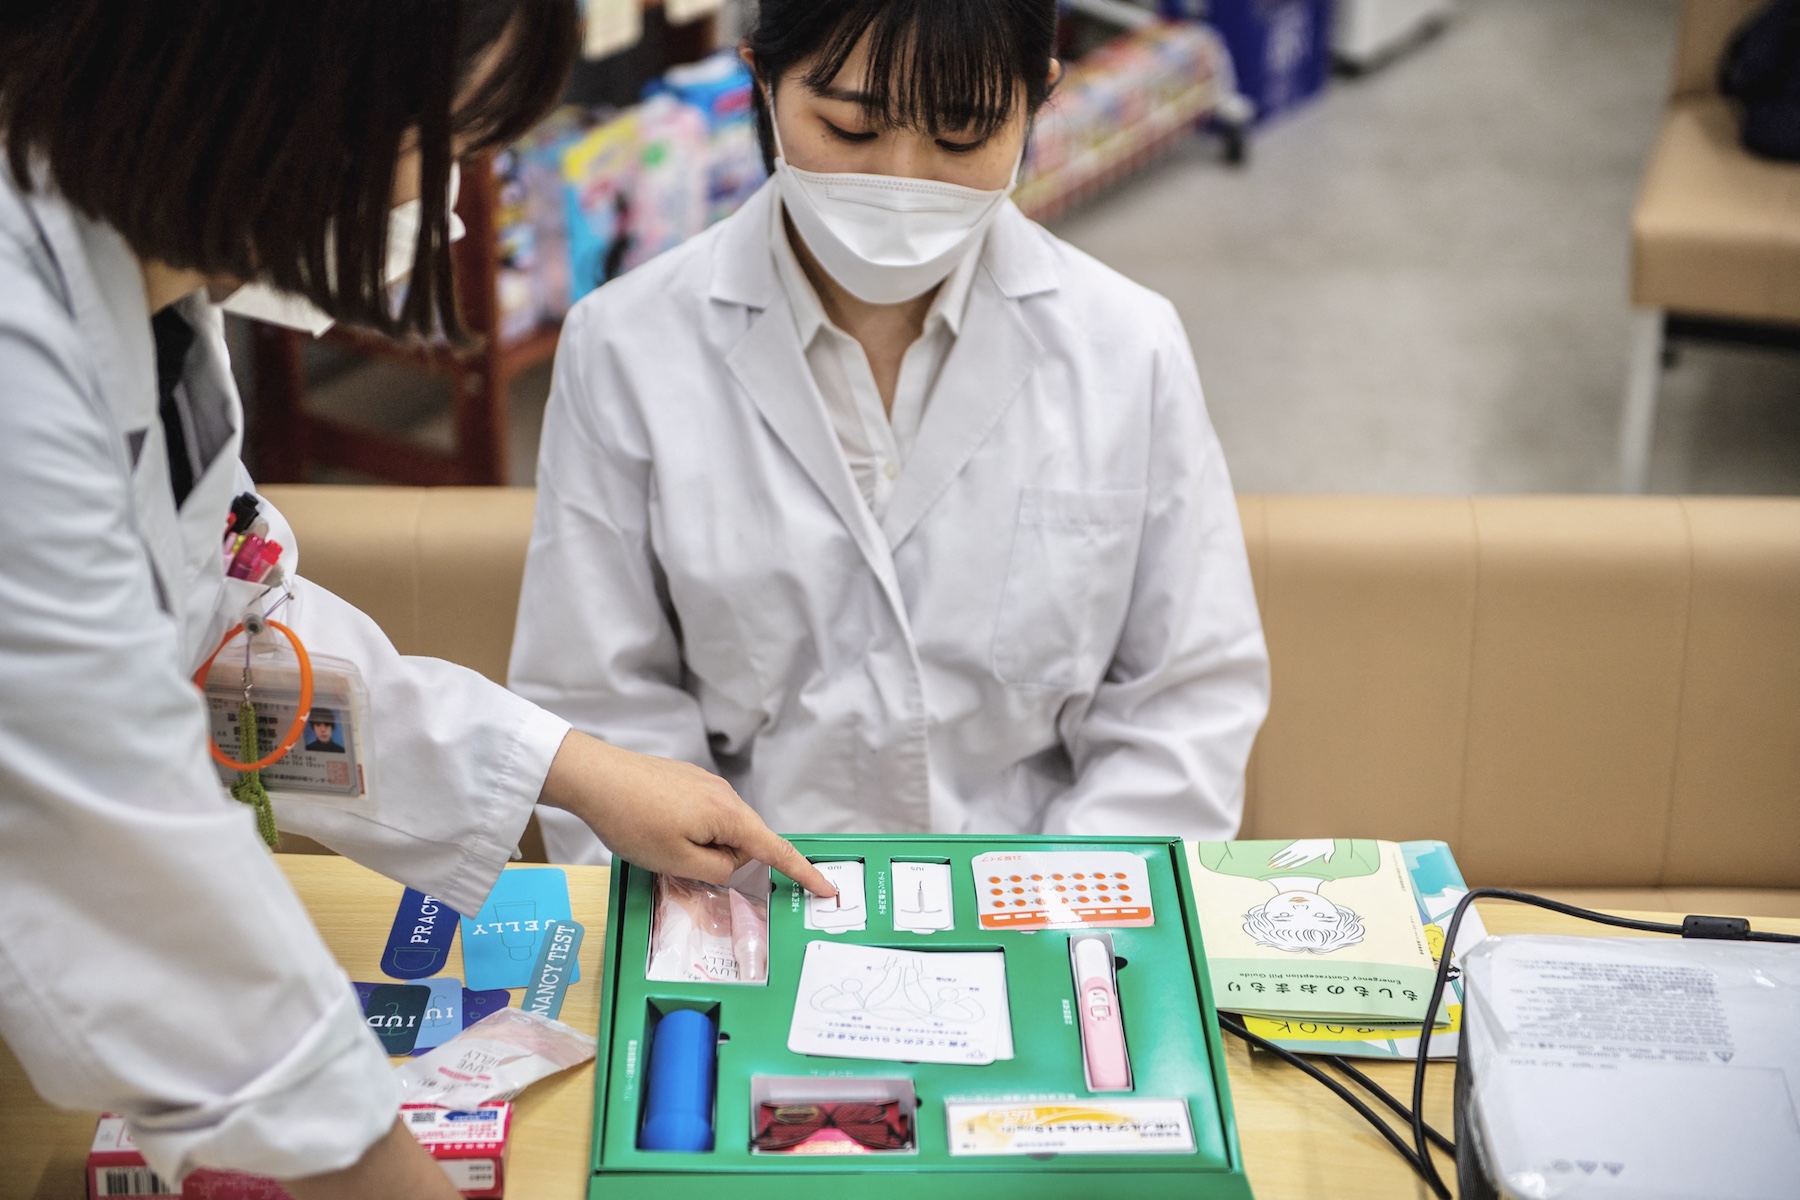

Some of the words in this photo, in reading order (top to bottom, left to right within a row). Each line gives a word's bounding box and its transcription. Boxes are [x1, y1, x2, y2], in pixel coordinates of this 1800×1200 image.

[547, 925, 576, 962] TEST
[1285, 972, 1350, 981] Contraception
[1353, 975, 1402, 985] Emergency
[1227, 981, 1418, 1001] もしものおまもり
[366, 1015, 417, 1028] IUD
